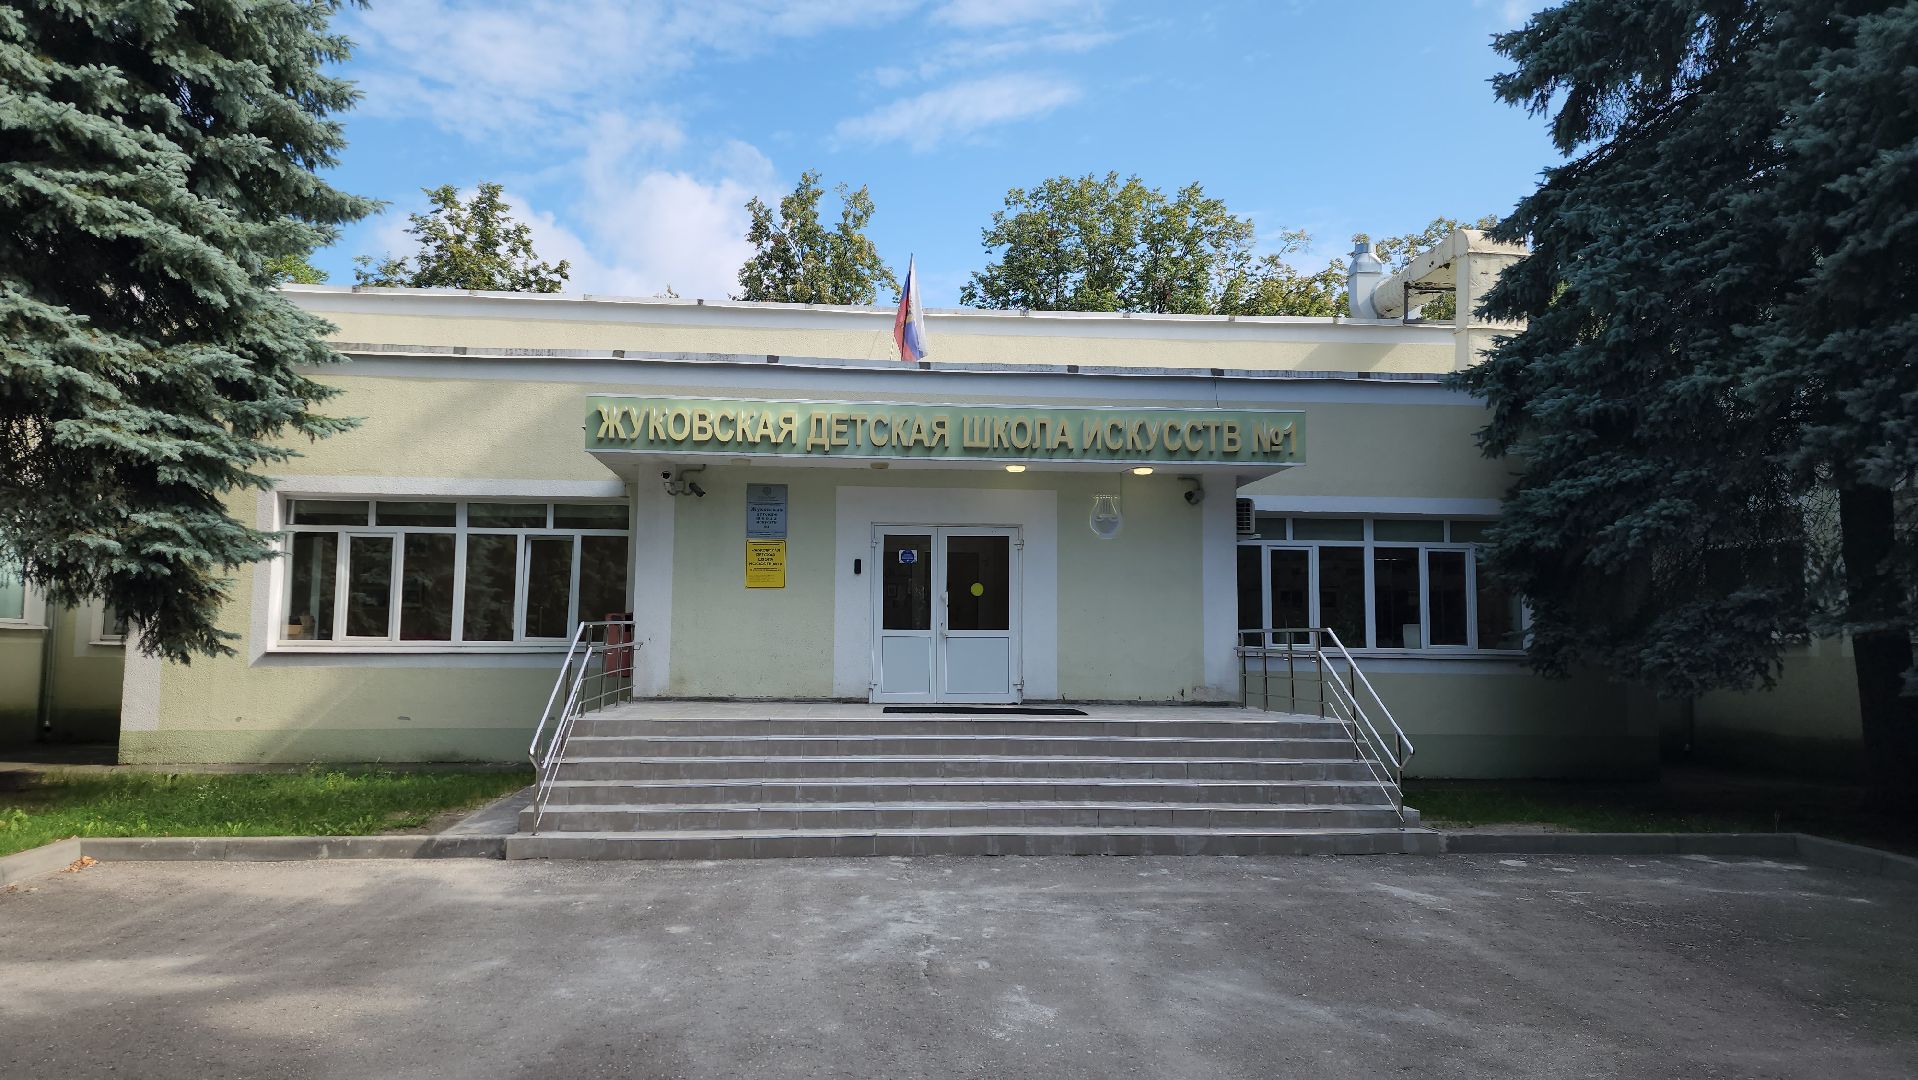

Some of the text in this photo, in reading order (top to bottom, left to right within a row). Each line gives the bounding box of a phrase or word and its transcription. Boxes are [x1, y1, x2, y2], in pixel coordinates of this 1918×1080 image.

[596, 408, 1297, 455] ЖУКОВСКАЯ ДЕТСКАЯ ШКОЛА ИСКУССТВ №1
